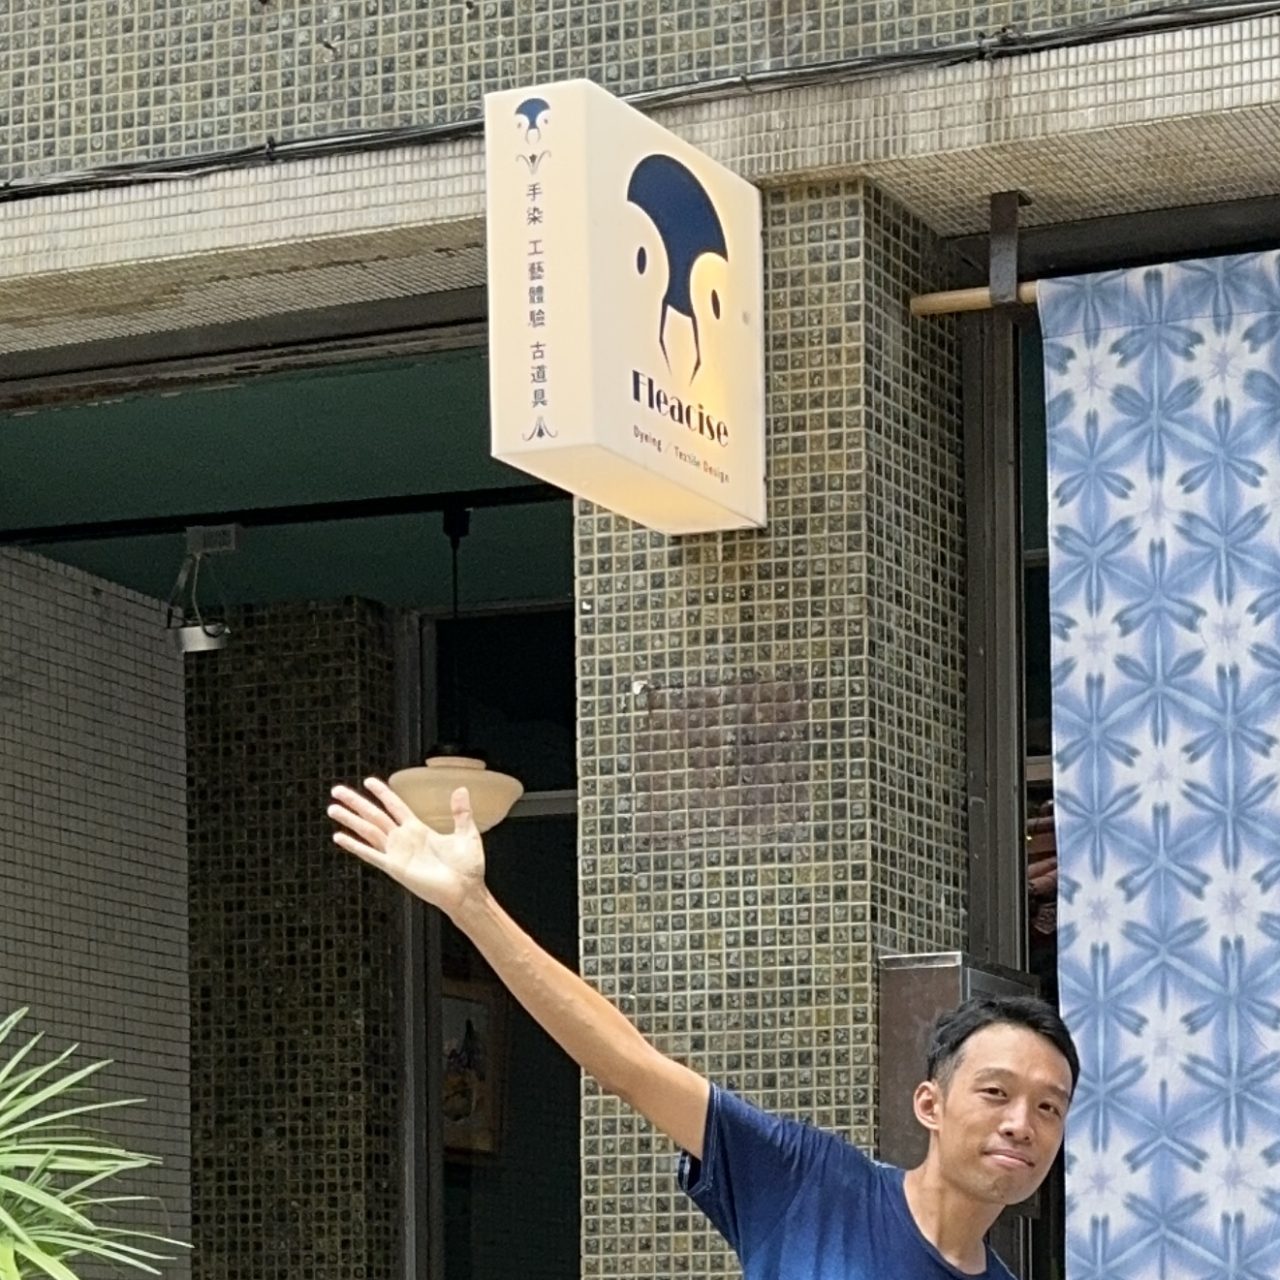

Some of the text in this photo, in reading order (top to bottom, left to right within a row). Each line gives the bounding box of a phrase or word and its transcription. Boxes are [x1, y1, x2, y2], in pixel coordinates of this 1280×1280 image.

[526, 182, 548, 408] 手染 工藝體驗 古道具
[632, 369, 729, 448] Fleacise
[702, 460, 730, 484] Design
